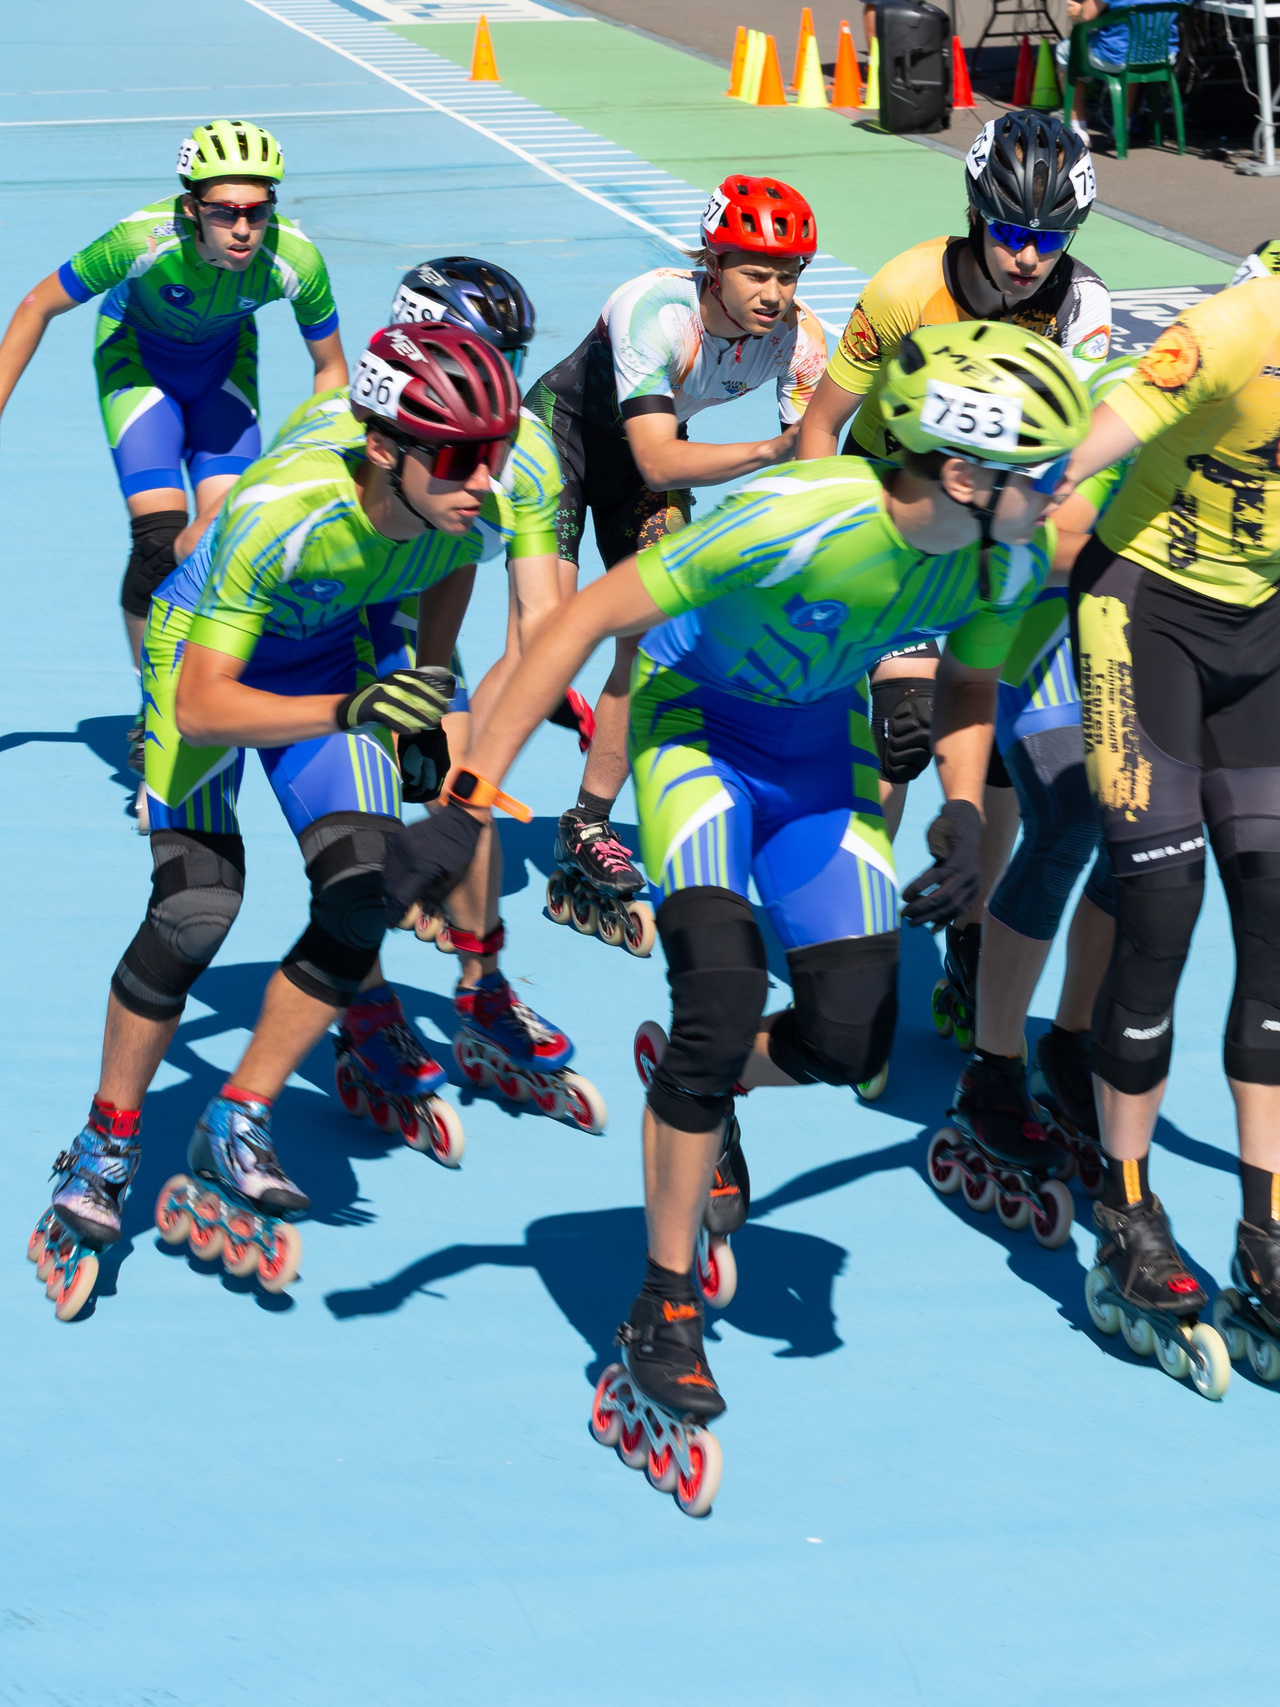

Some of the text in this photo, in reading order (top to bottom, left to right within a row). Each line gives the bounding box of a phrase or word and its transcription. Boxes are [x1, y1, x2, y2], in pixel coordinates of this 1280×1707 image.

[1074, 165, 1096, 196] 75
[702, 195, 722, 222] 57
[384, 328, 430, 364] MET
[932, 345, 1008, 384] MET
[355, 360, 394, 406] 756
[933, 392, 1005, 439] 753
